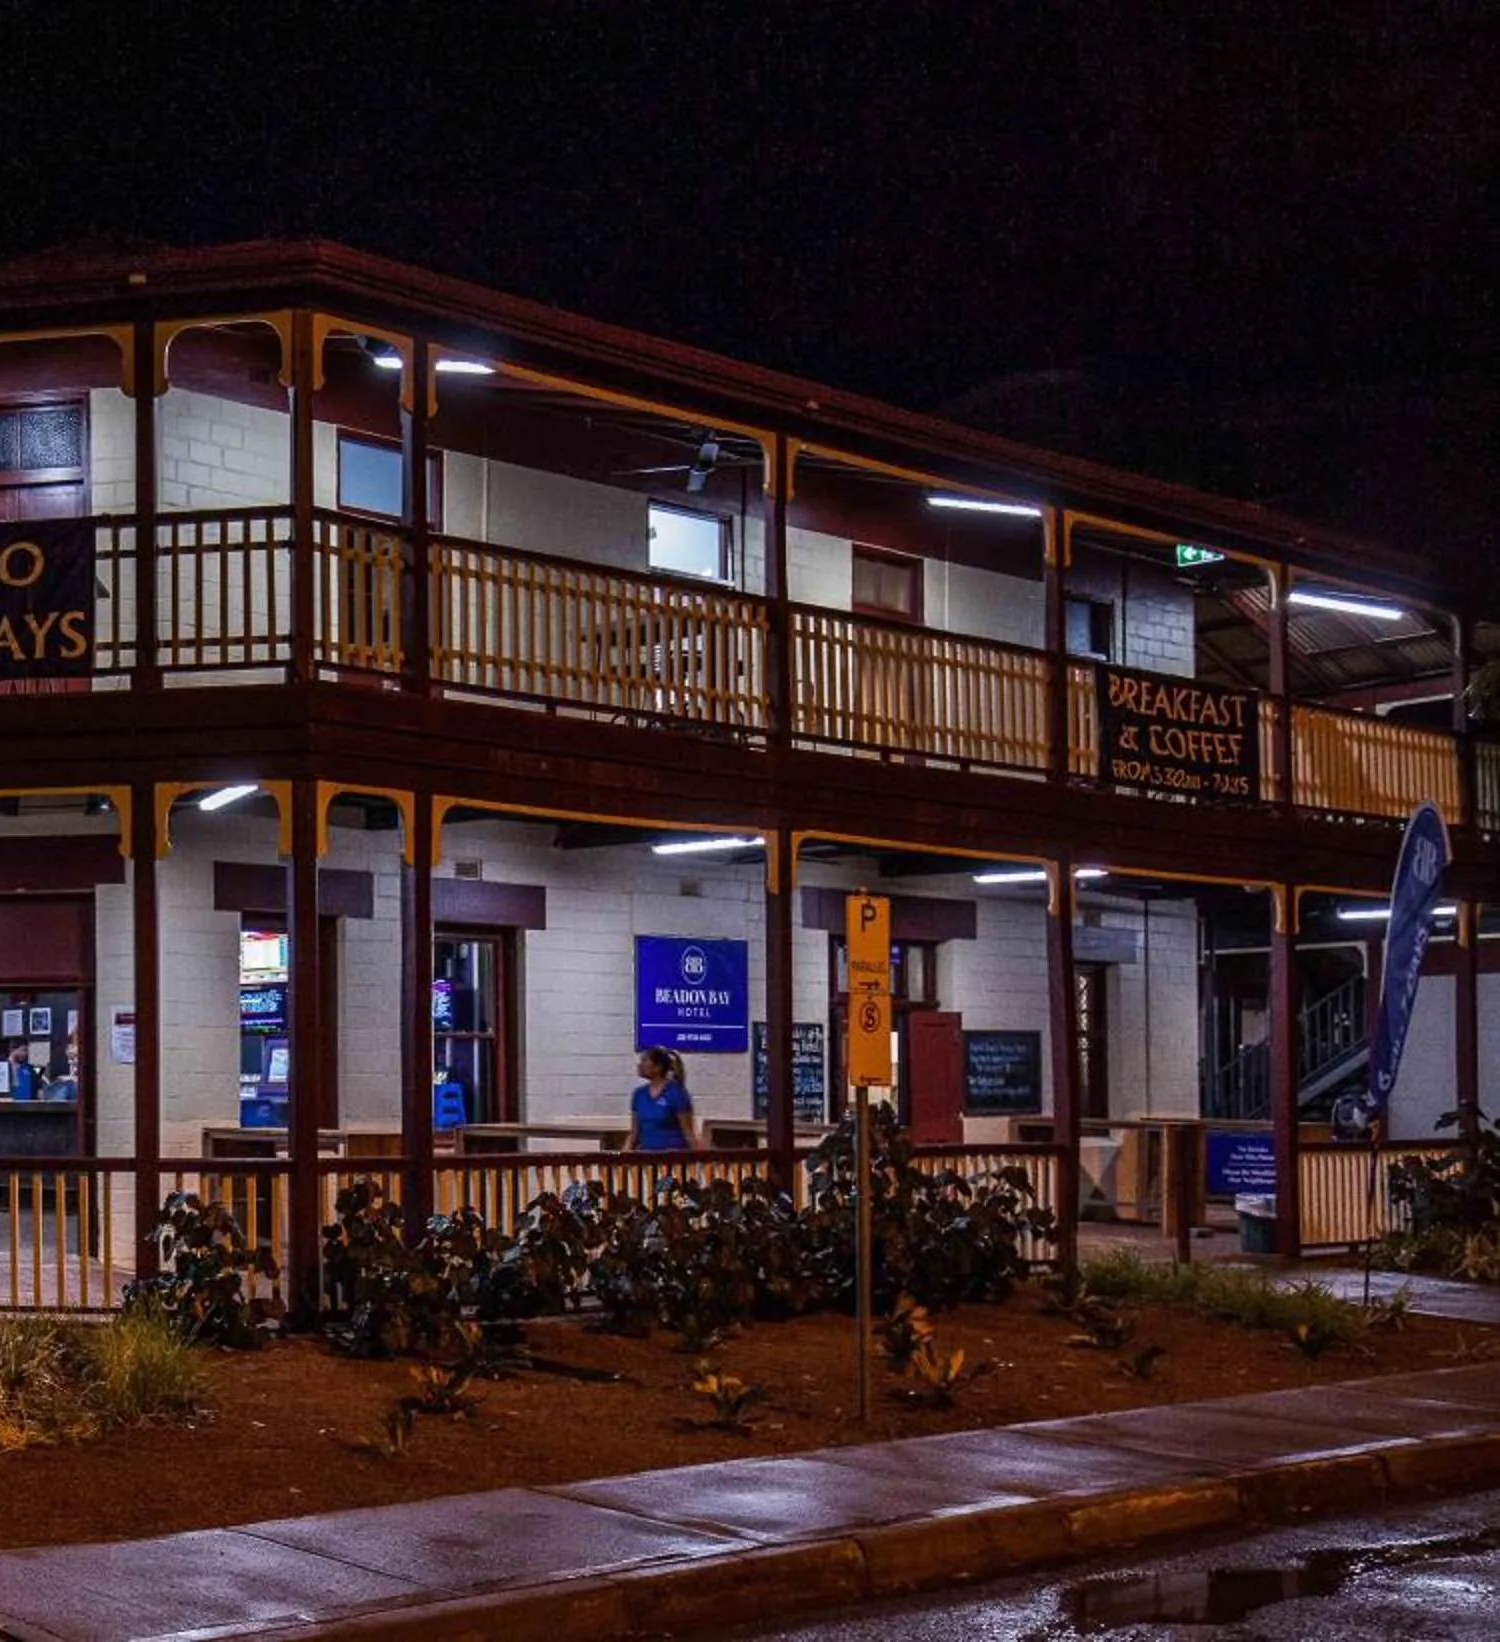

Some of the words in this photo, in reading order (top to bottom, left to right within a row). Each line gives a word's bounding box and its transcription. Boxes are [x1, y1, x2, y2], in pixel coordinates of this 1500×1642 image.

[1108, 672, 1248, 727] BREAKFAST
[861, 903, 877, 932] P
[655, 988, 706, 1005] BEADON
[708, 990, 730, 1005] BAY
[677, 1007, 711, 1018] HOTEL
